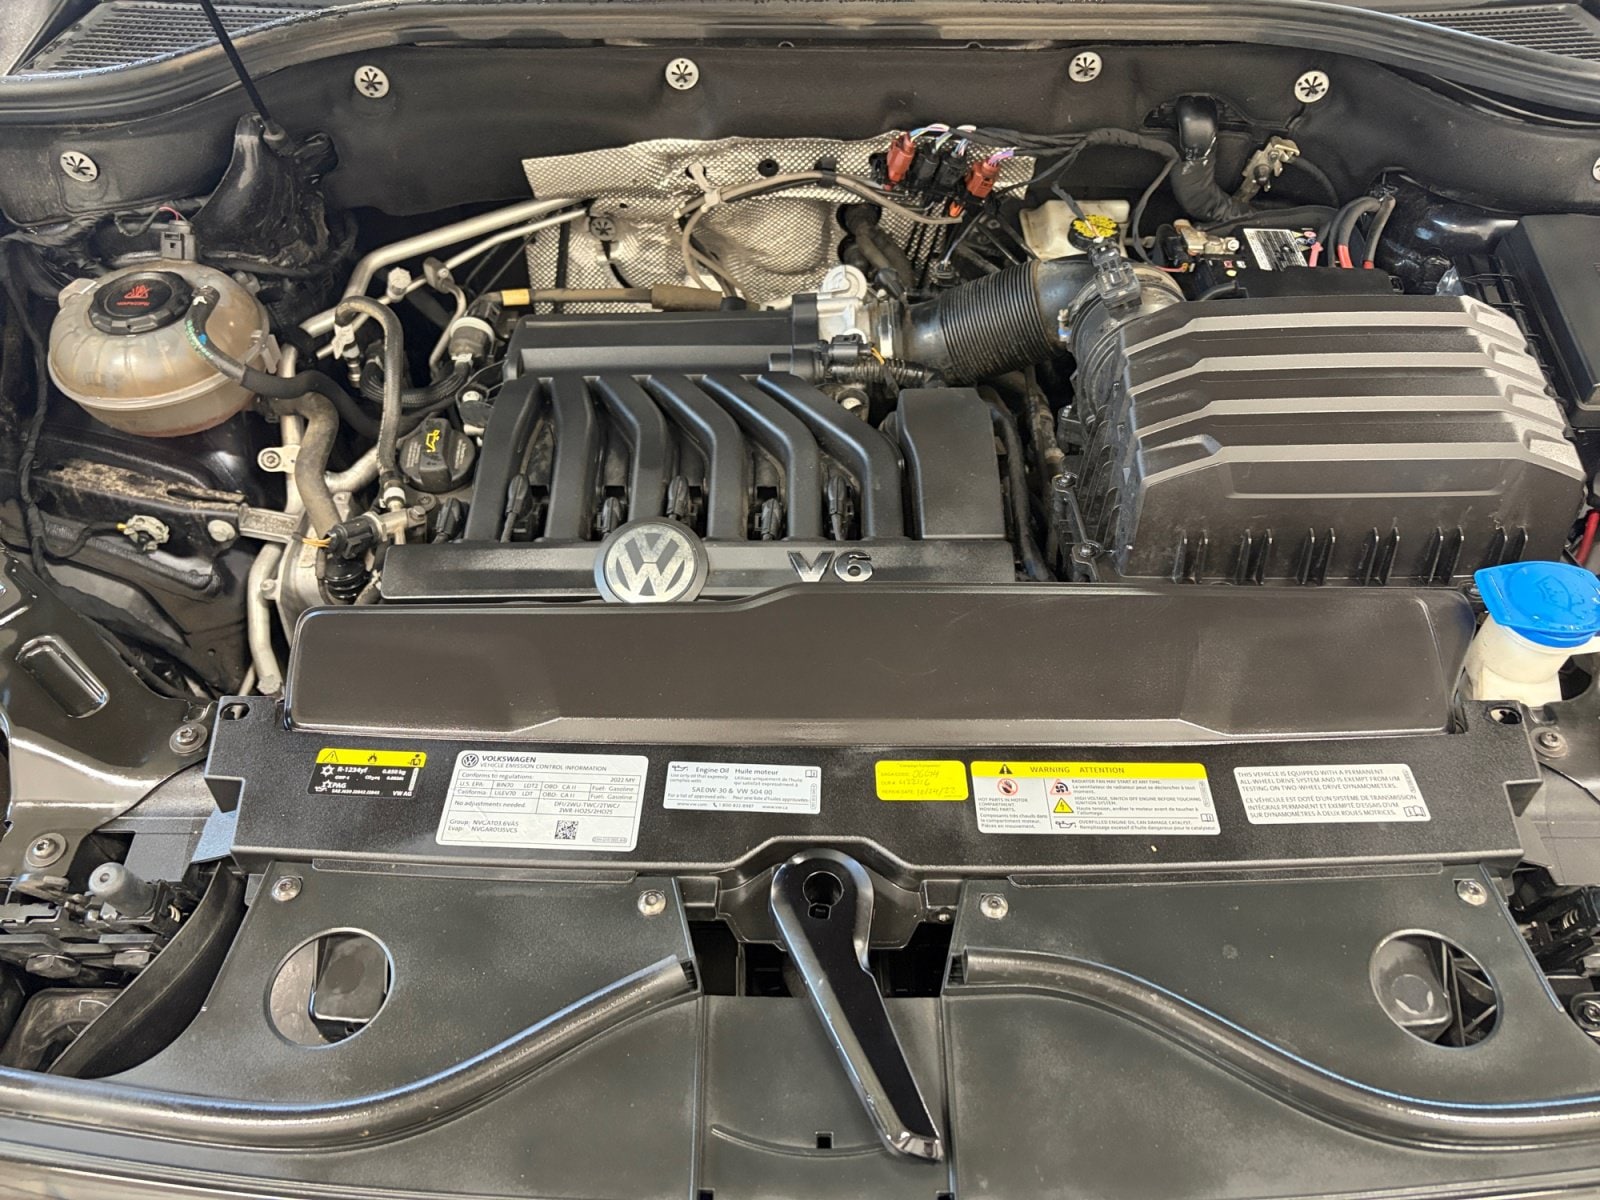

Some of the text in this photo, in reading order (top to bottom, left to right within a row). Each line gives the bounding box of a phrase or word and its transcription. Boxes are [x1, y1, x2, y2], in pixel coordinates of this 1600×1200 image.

[787, 549, 872, 583] V6
[482, 755, 537, 763] VOLKSWAGEN
[696, 766, 719, 774] Engine
